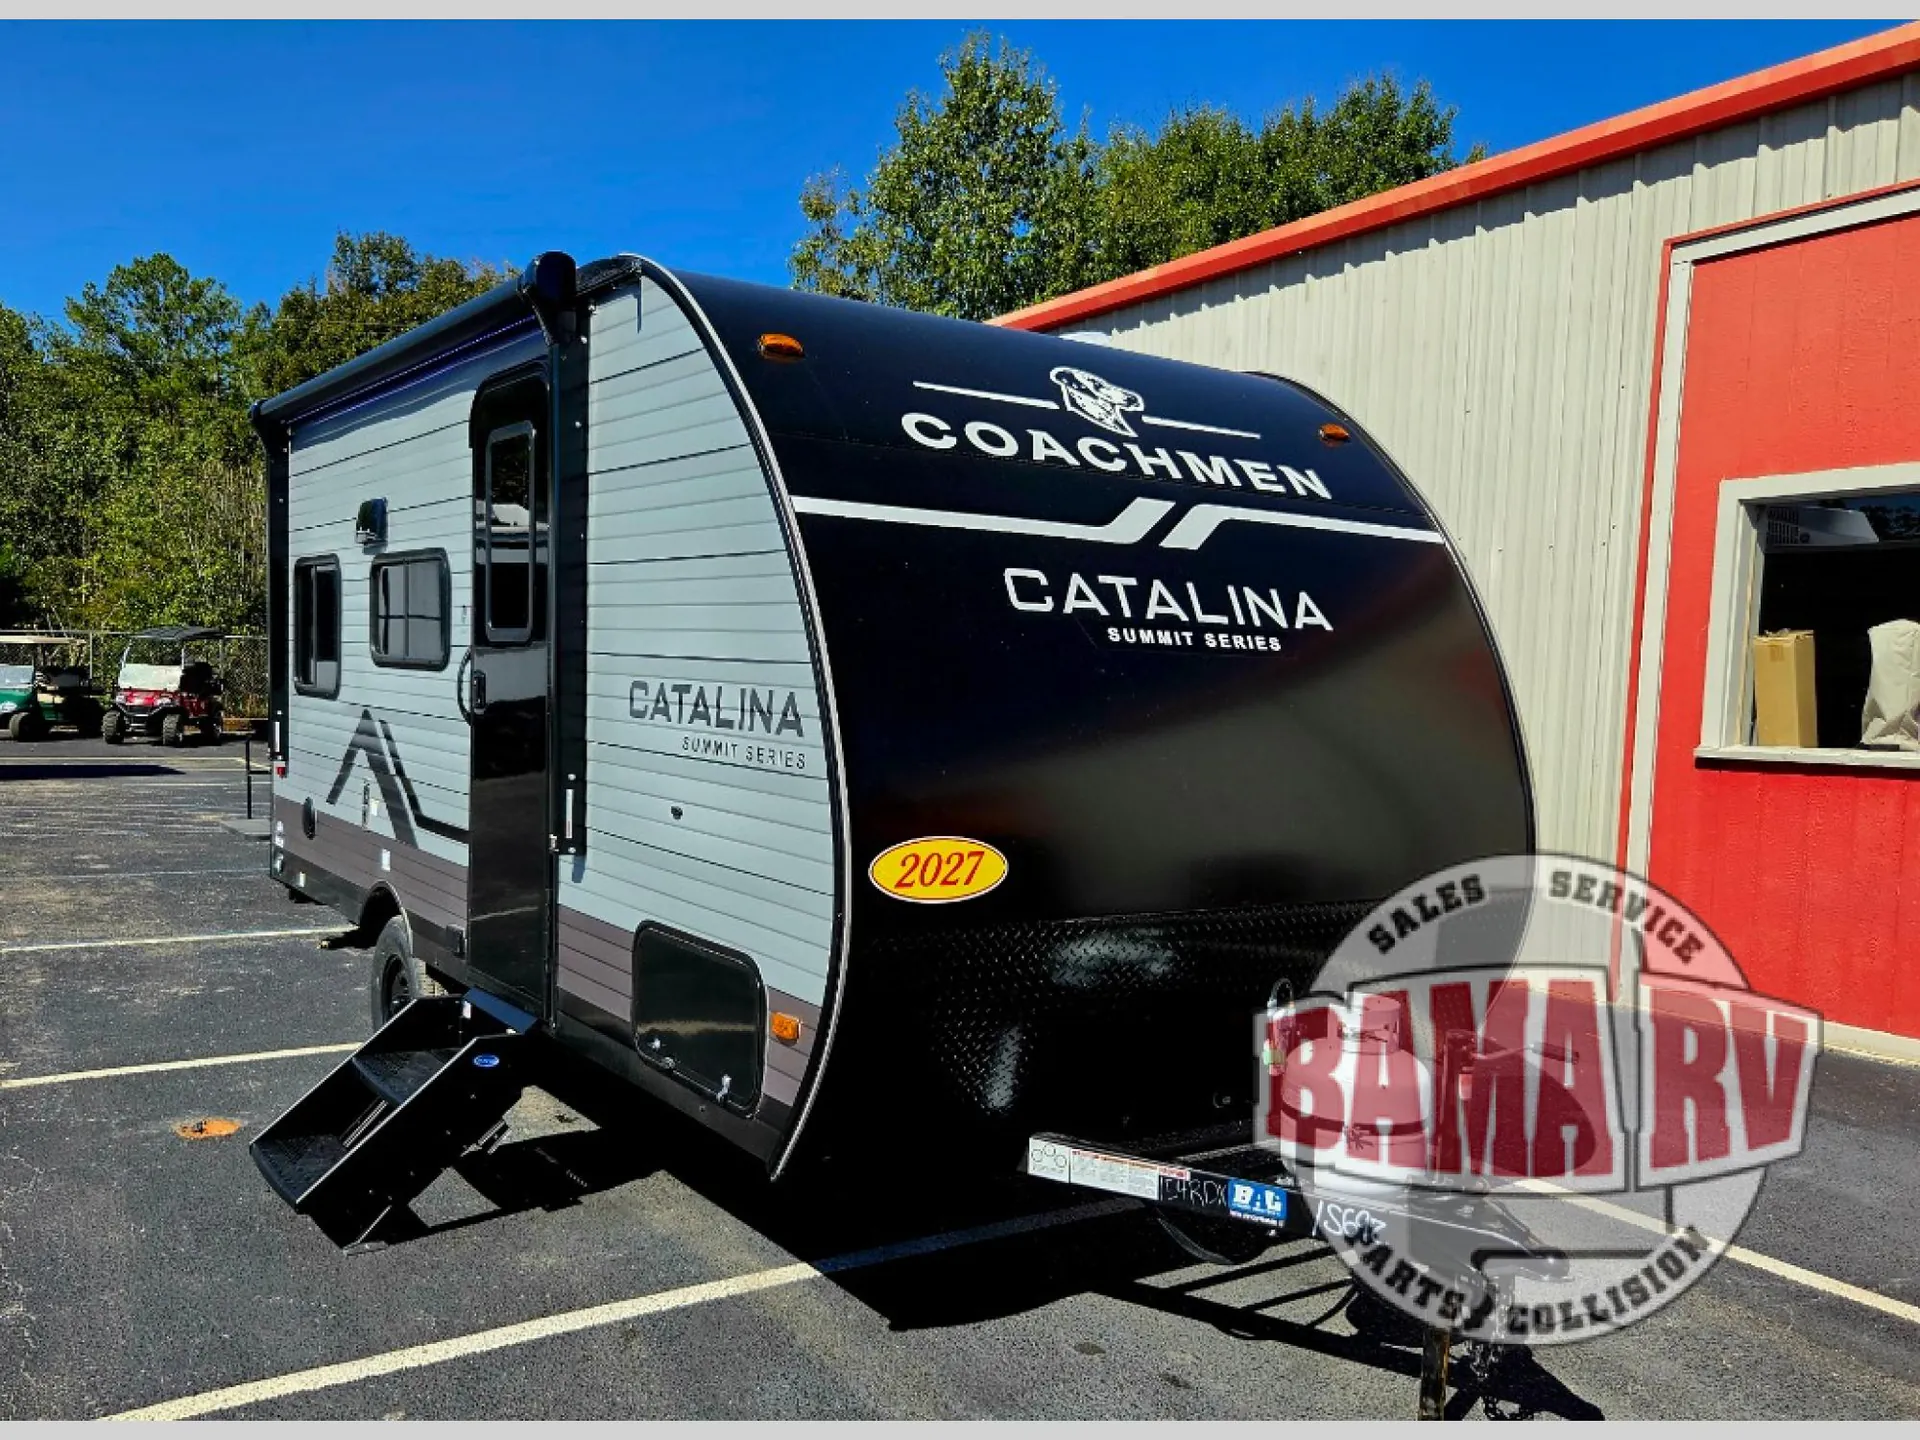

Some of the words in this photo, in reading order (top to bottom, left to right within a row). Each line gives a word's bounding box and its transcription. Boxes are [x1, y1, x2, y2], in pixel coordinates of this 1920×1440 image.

[901, 412, 1332, 500] COACHMEN
[1003, 567, 1334, 631] CATALINA
[1107, 627, 1193, 646] SUMMIT
[1204, 633, 1281, 651] SERIES
[629, 680, 804, 738] CATALINA
[682, 736, 738, 759] SUMMIT
[746, 746, 806, 770] SERIES
[893, 850, 985, 889] 2027
